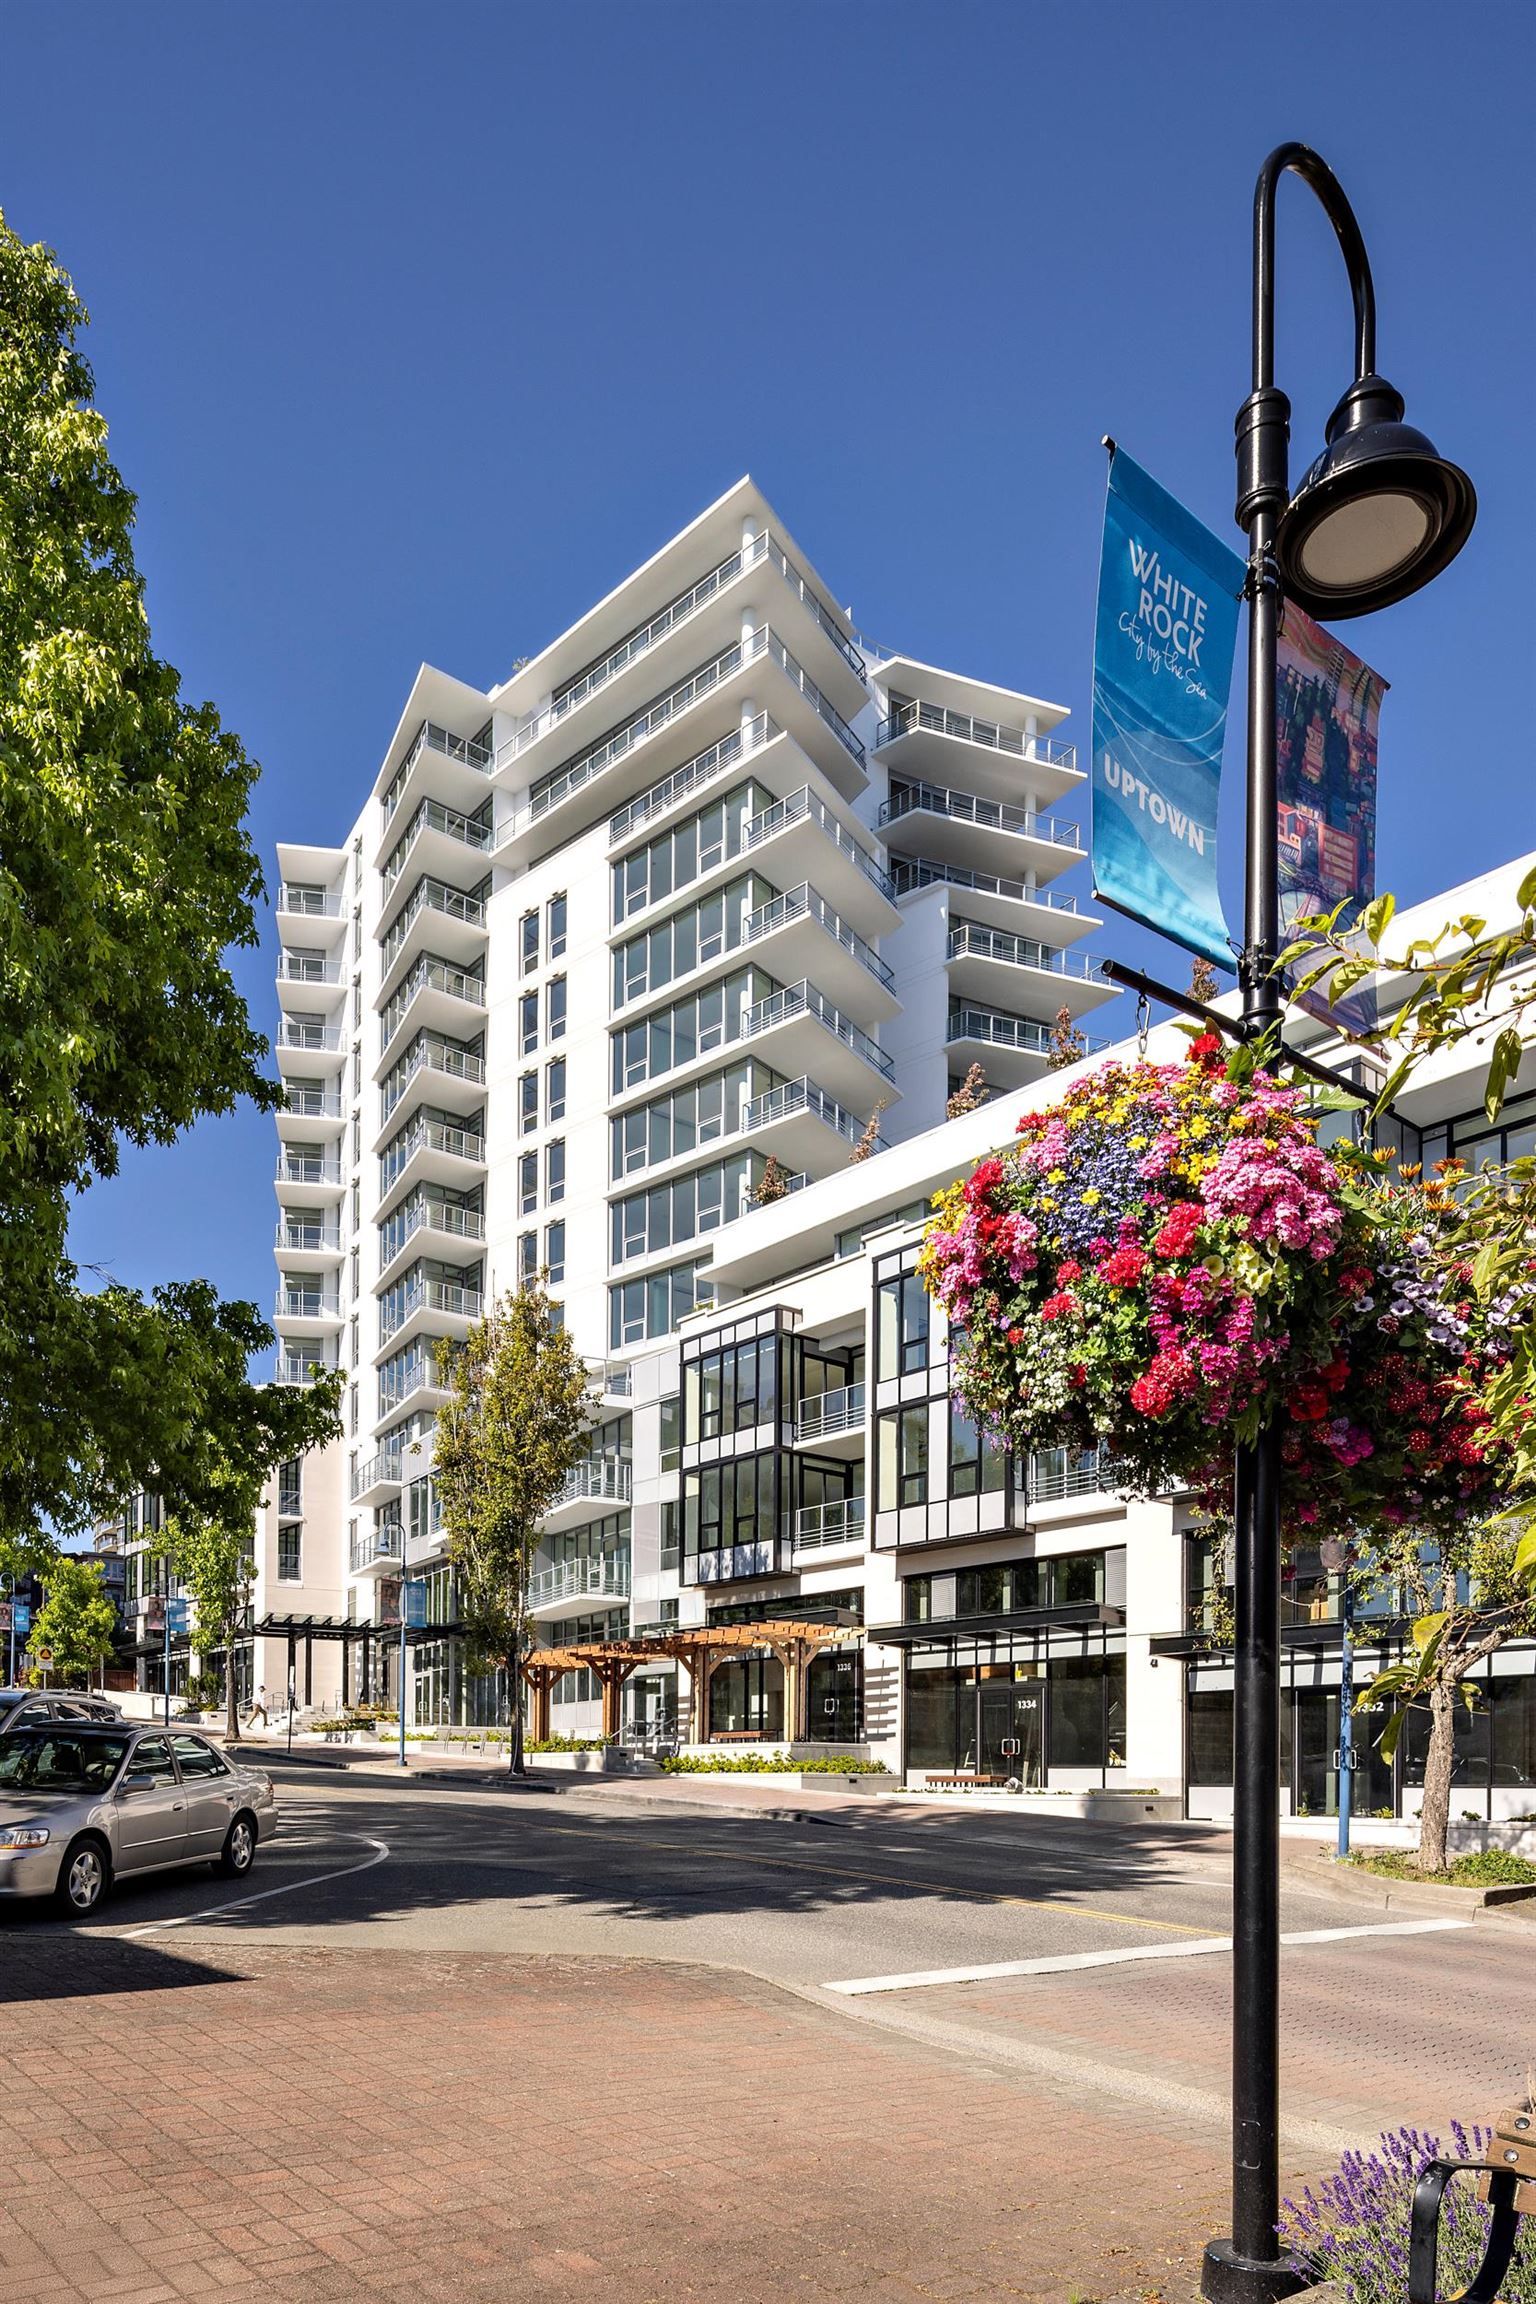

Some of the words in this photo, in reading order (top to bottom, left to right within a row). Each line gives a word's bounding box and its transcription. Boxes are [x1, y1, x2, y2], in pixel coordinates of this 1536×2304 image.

[1129, 538, 1208, 634] WHITE
[1138, 587, 1203, 668] ROCK
[1118, 611, 1145, 661] City
[1147, 632, 1161, 675] by
[1162, 642, 1184, 680] the
[1185, 668, 1207, 700] Sea
[1104, 752, 1204, 856] UPTOWN
[1017, 1700, 1037, 1709] 1334
